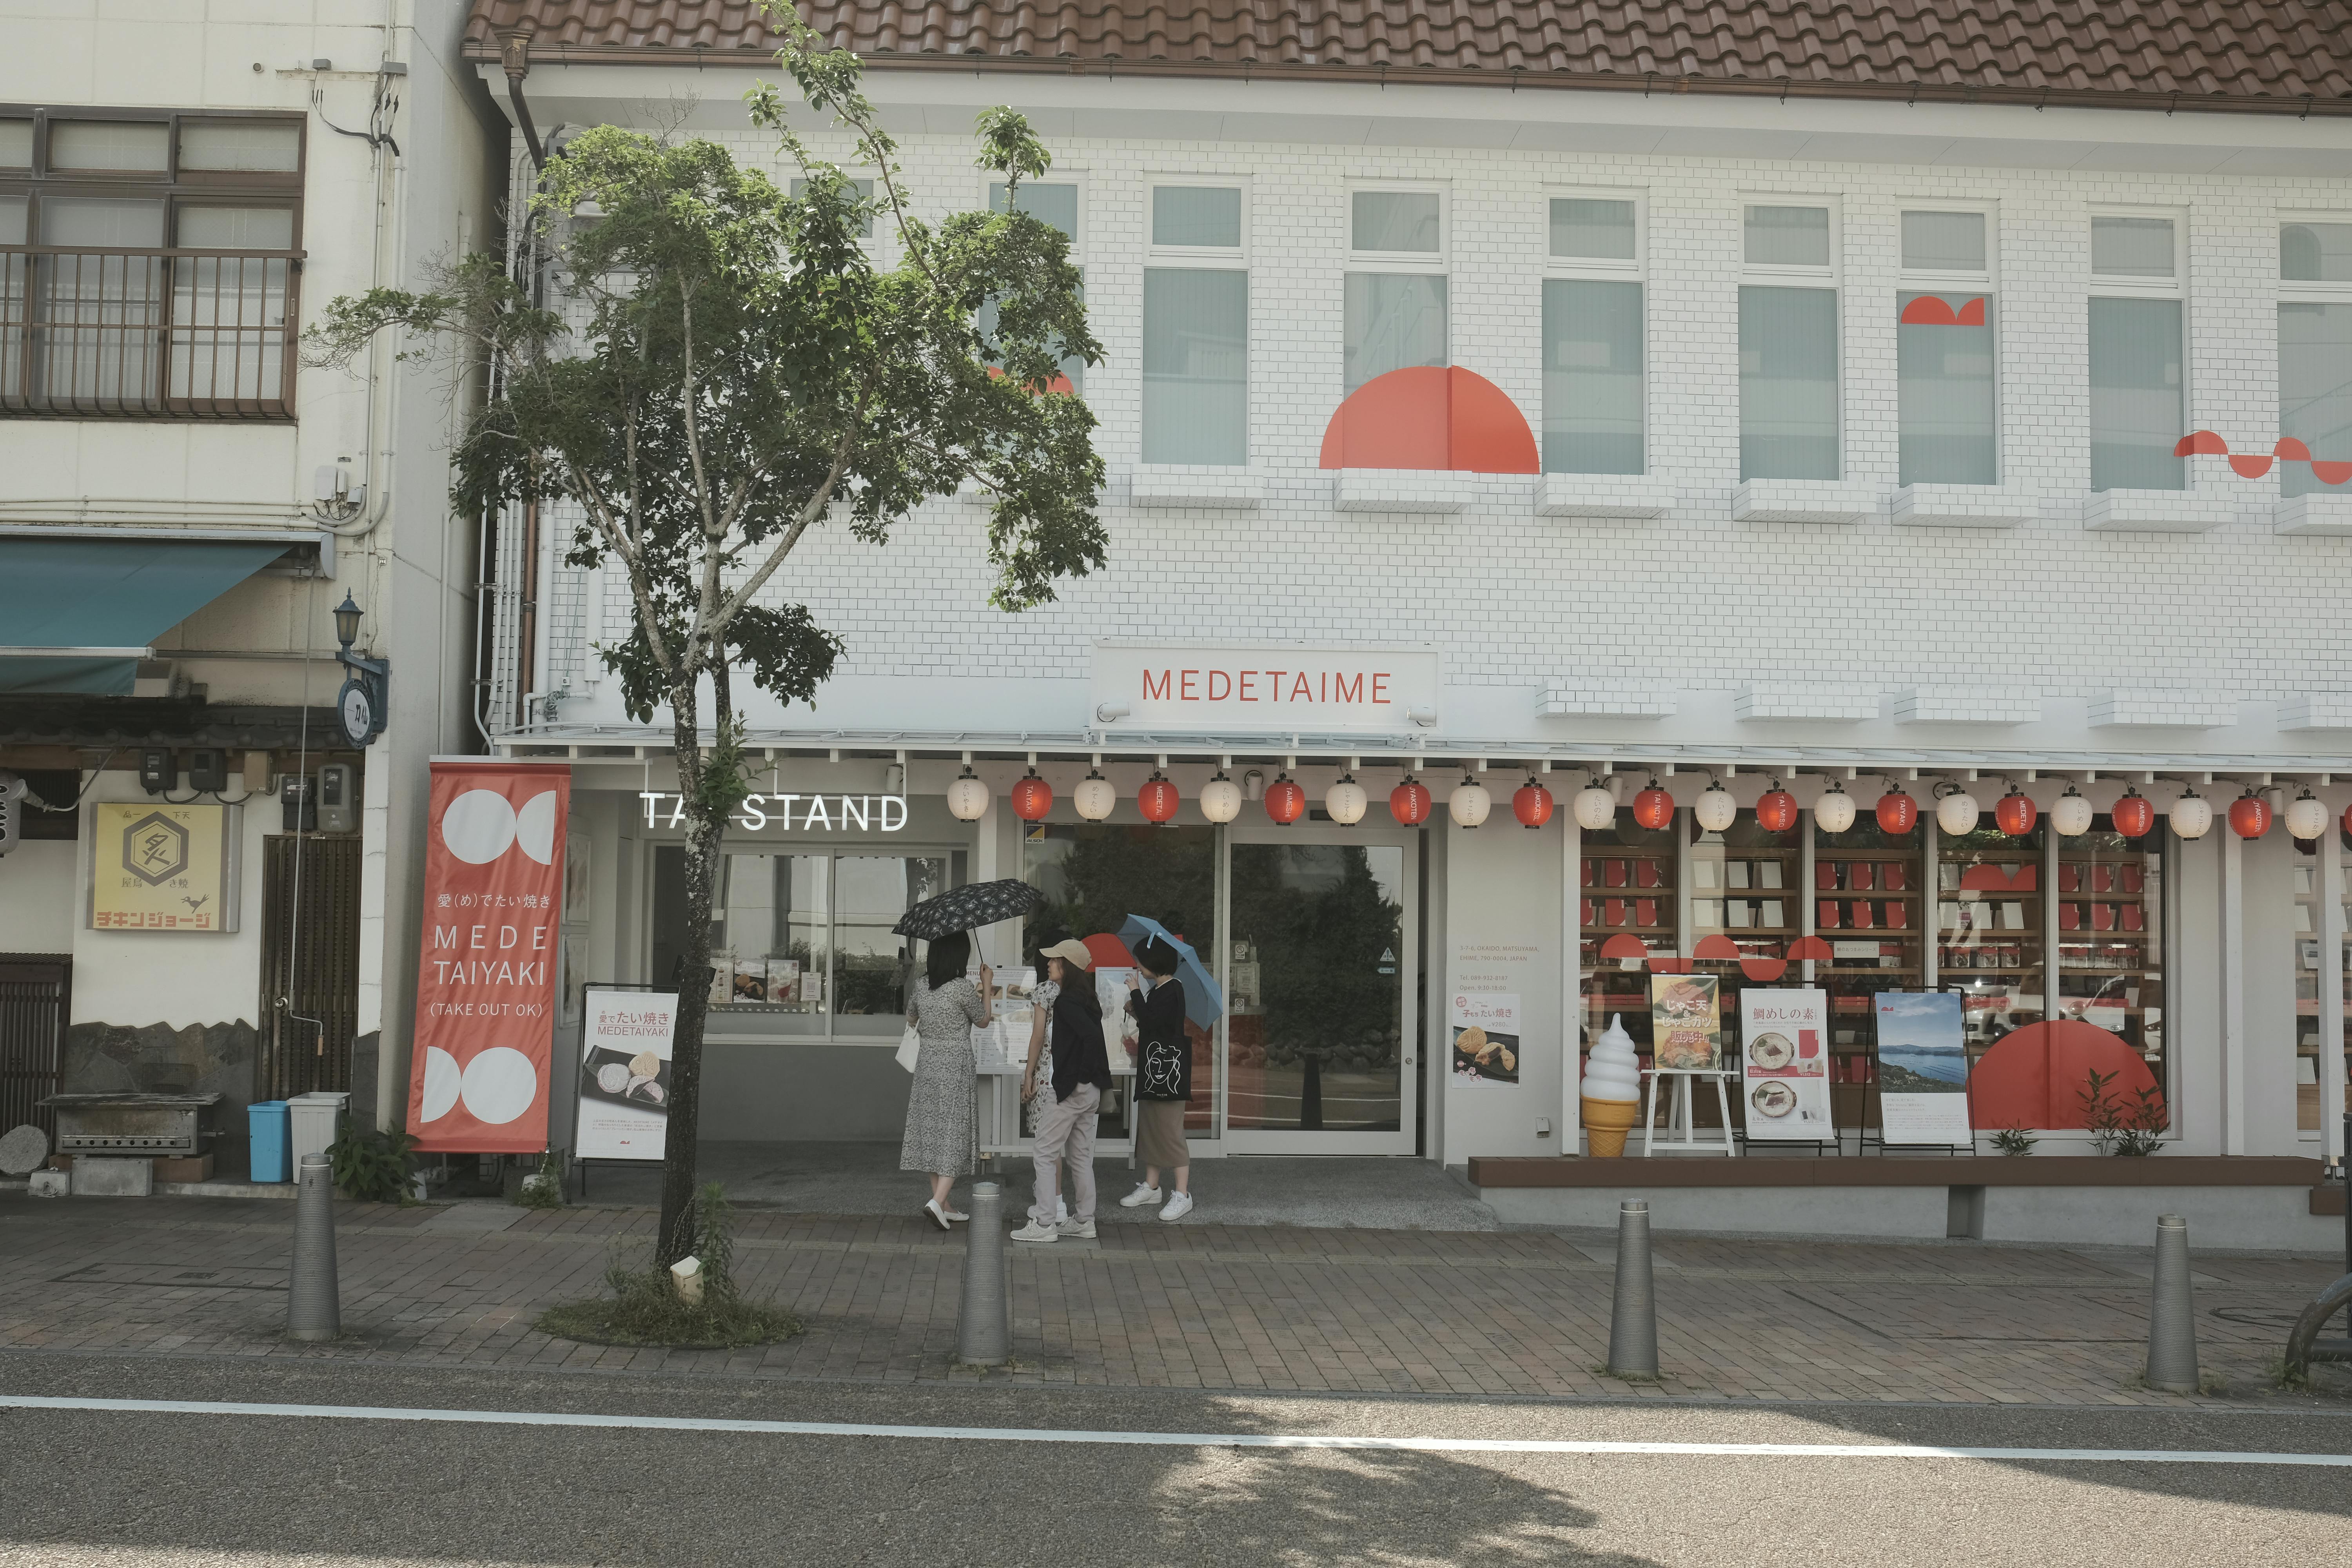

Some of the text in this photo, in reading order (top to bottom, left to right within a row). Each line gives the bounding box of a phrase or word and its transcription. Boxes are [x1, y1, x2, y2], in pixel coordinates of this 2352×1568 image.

[1143, 669, 1391, 704] MEDETAIME
[741, 793, 907, 831] STAND
[1534, 788, 1542, 822] JYAKOKATSU
[1655, 805, 1661, 815] NO
[2137, 801, 2145, 832] TAIMESHI
[2253, 800, 2263, 832] JYAKOTEN
[142, 833, 170, 866] 炙
[97, 911, 211, 928] チキンジョージ
[435, 925, 546, 950] MEDE
[434, 961, 544, 985] TAIYAKI
[431, 1002, 543, 1018] (TAKE OUT OK)
[1481, 1008, 1512, 1018] たい焼き
[1666, 1000, 1707, 1011] じゃこ天
[1753, 1007, 1814, 1020] 鯛めしの素
[598, 1026, 668, 1037] MEDETAIYAKI
[1662, 1016, 1713, 1027] じゃこカツ
